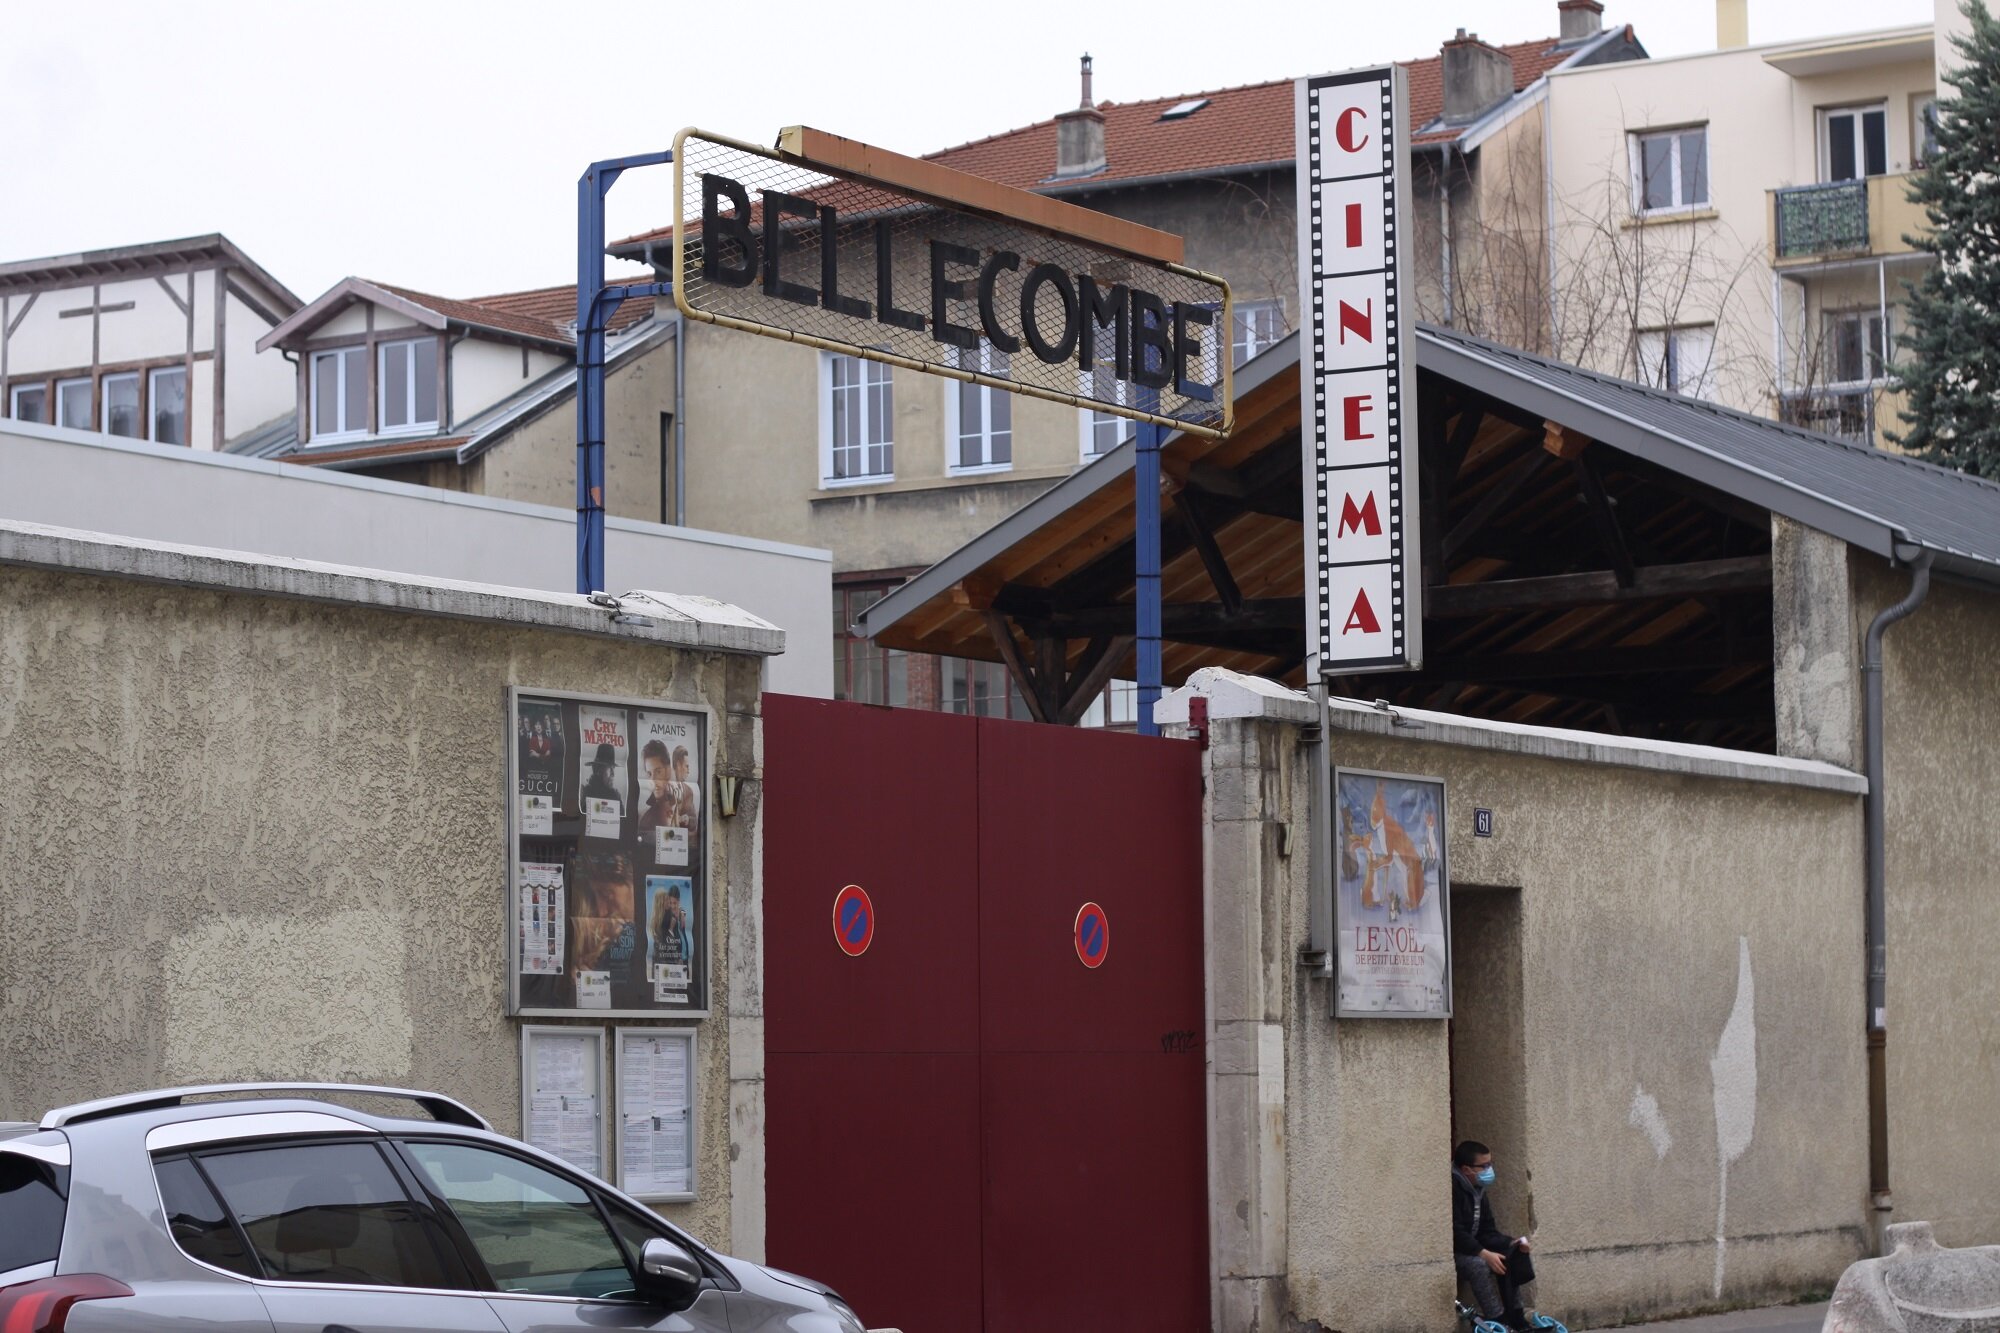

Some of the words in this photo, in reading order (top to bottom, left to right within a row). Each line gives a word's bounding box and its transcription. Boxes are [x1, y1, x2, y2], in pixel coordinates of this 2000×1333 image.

[702, 173, 1213, 401] BELLECOMBE
[1336, 106, 1382, 635] CINEMA
[594, 717, 617, 734] CRY
[650, 723, 686, 737] AMANTS
[584, 729, 625, 747] MACHO
[519, 779, 558, 793] GUCCI
[1478, 812, 1489, 832] 61
[620, 935, 635, 948] SON
[1355, 926, 1381, 952] LE
